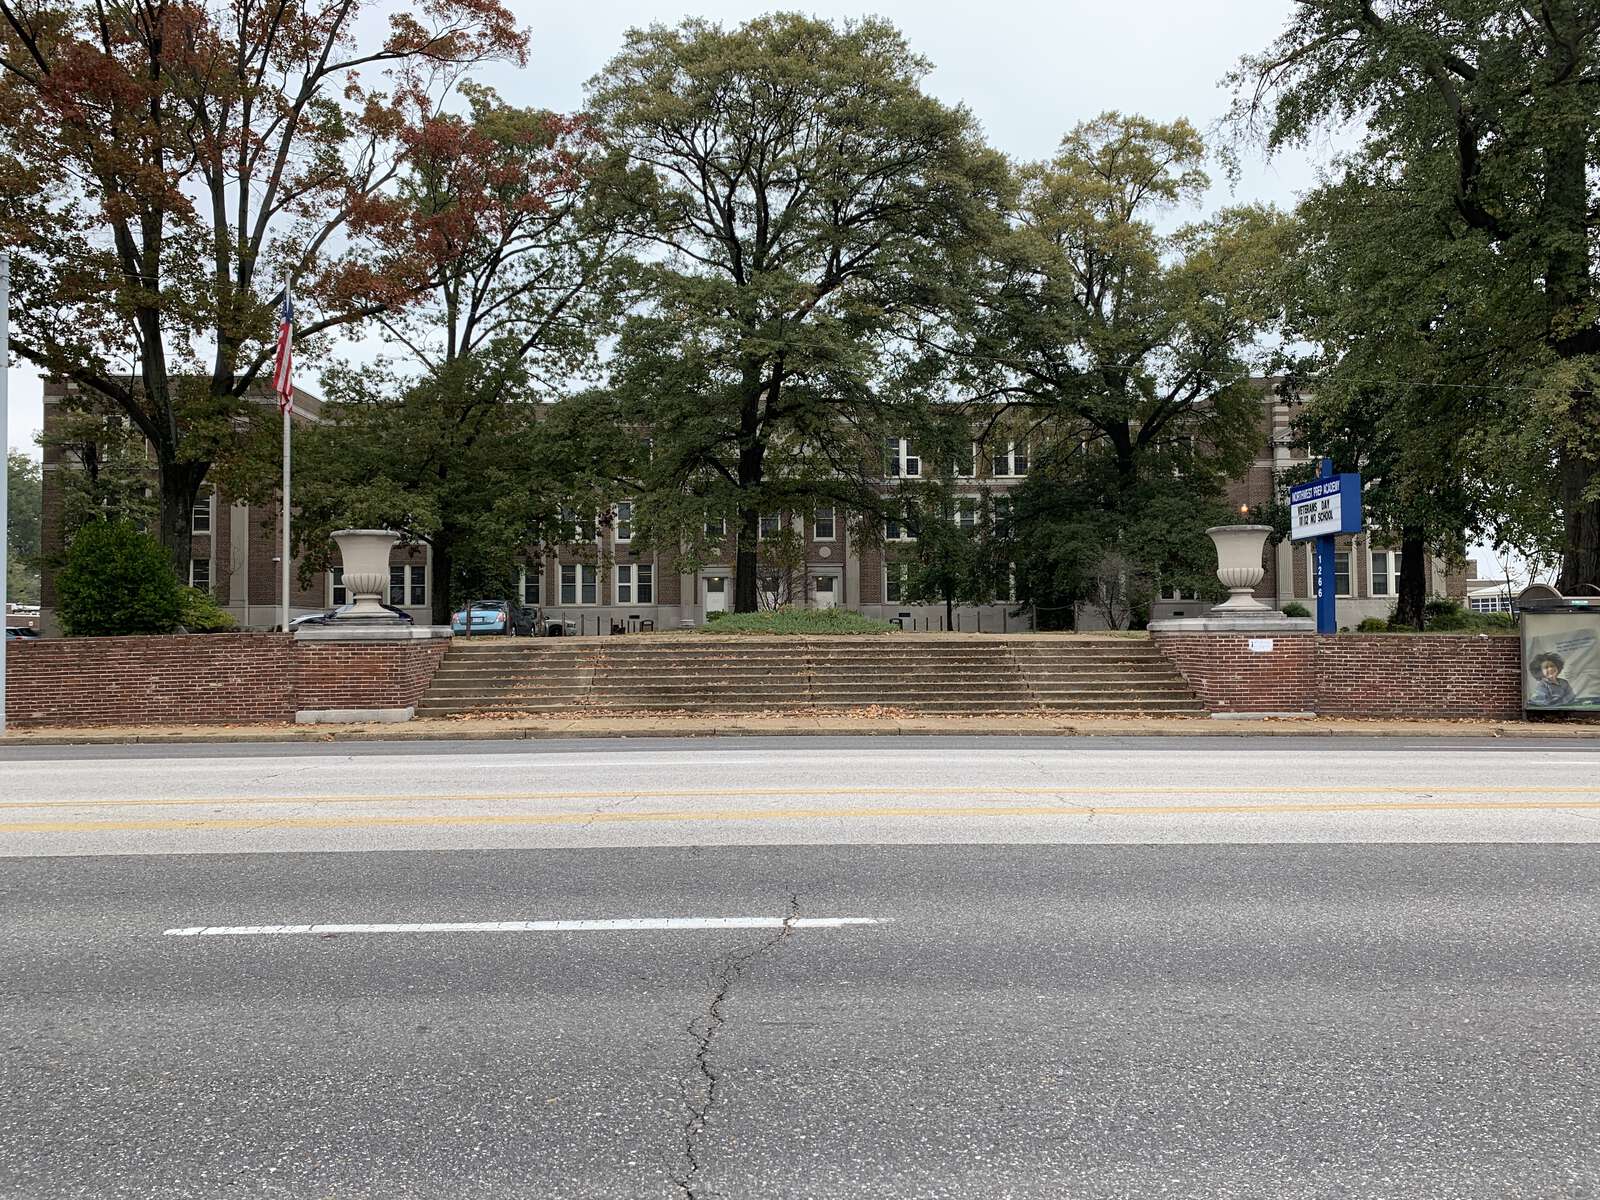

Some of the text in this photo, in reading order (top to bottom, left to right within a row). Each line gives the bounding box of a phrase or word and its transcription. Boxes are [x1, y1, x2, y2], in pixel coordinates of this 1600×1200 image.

[1292, 480, 1340, 502] NORTHWEST PREP ACADEMY
[1298, 499, 1330, 515] VETERANS DAY
[1310, 513, 1316, 523] NO
[1318, 510, 1333, 522] SCHOOL
